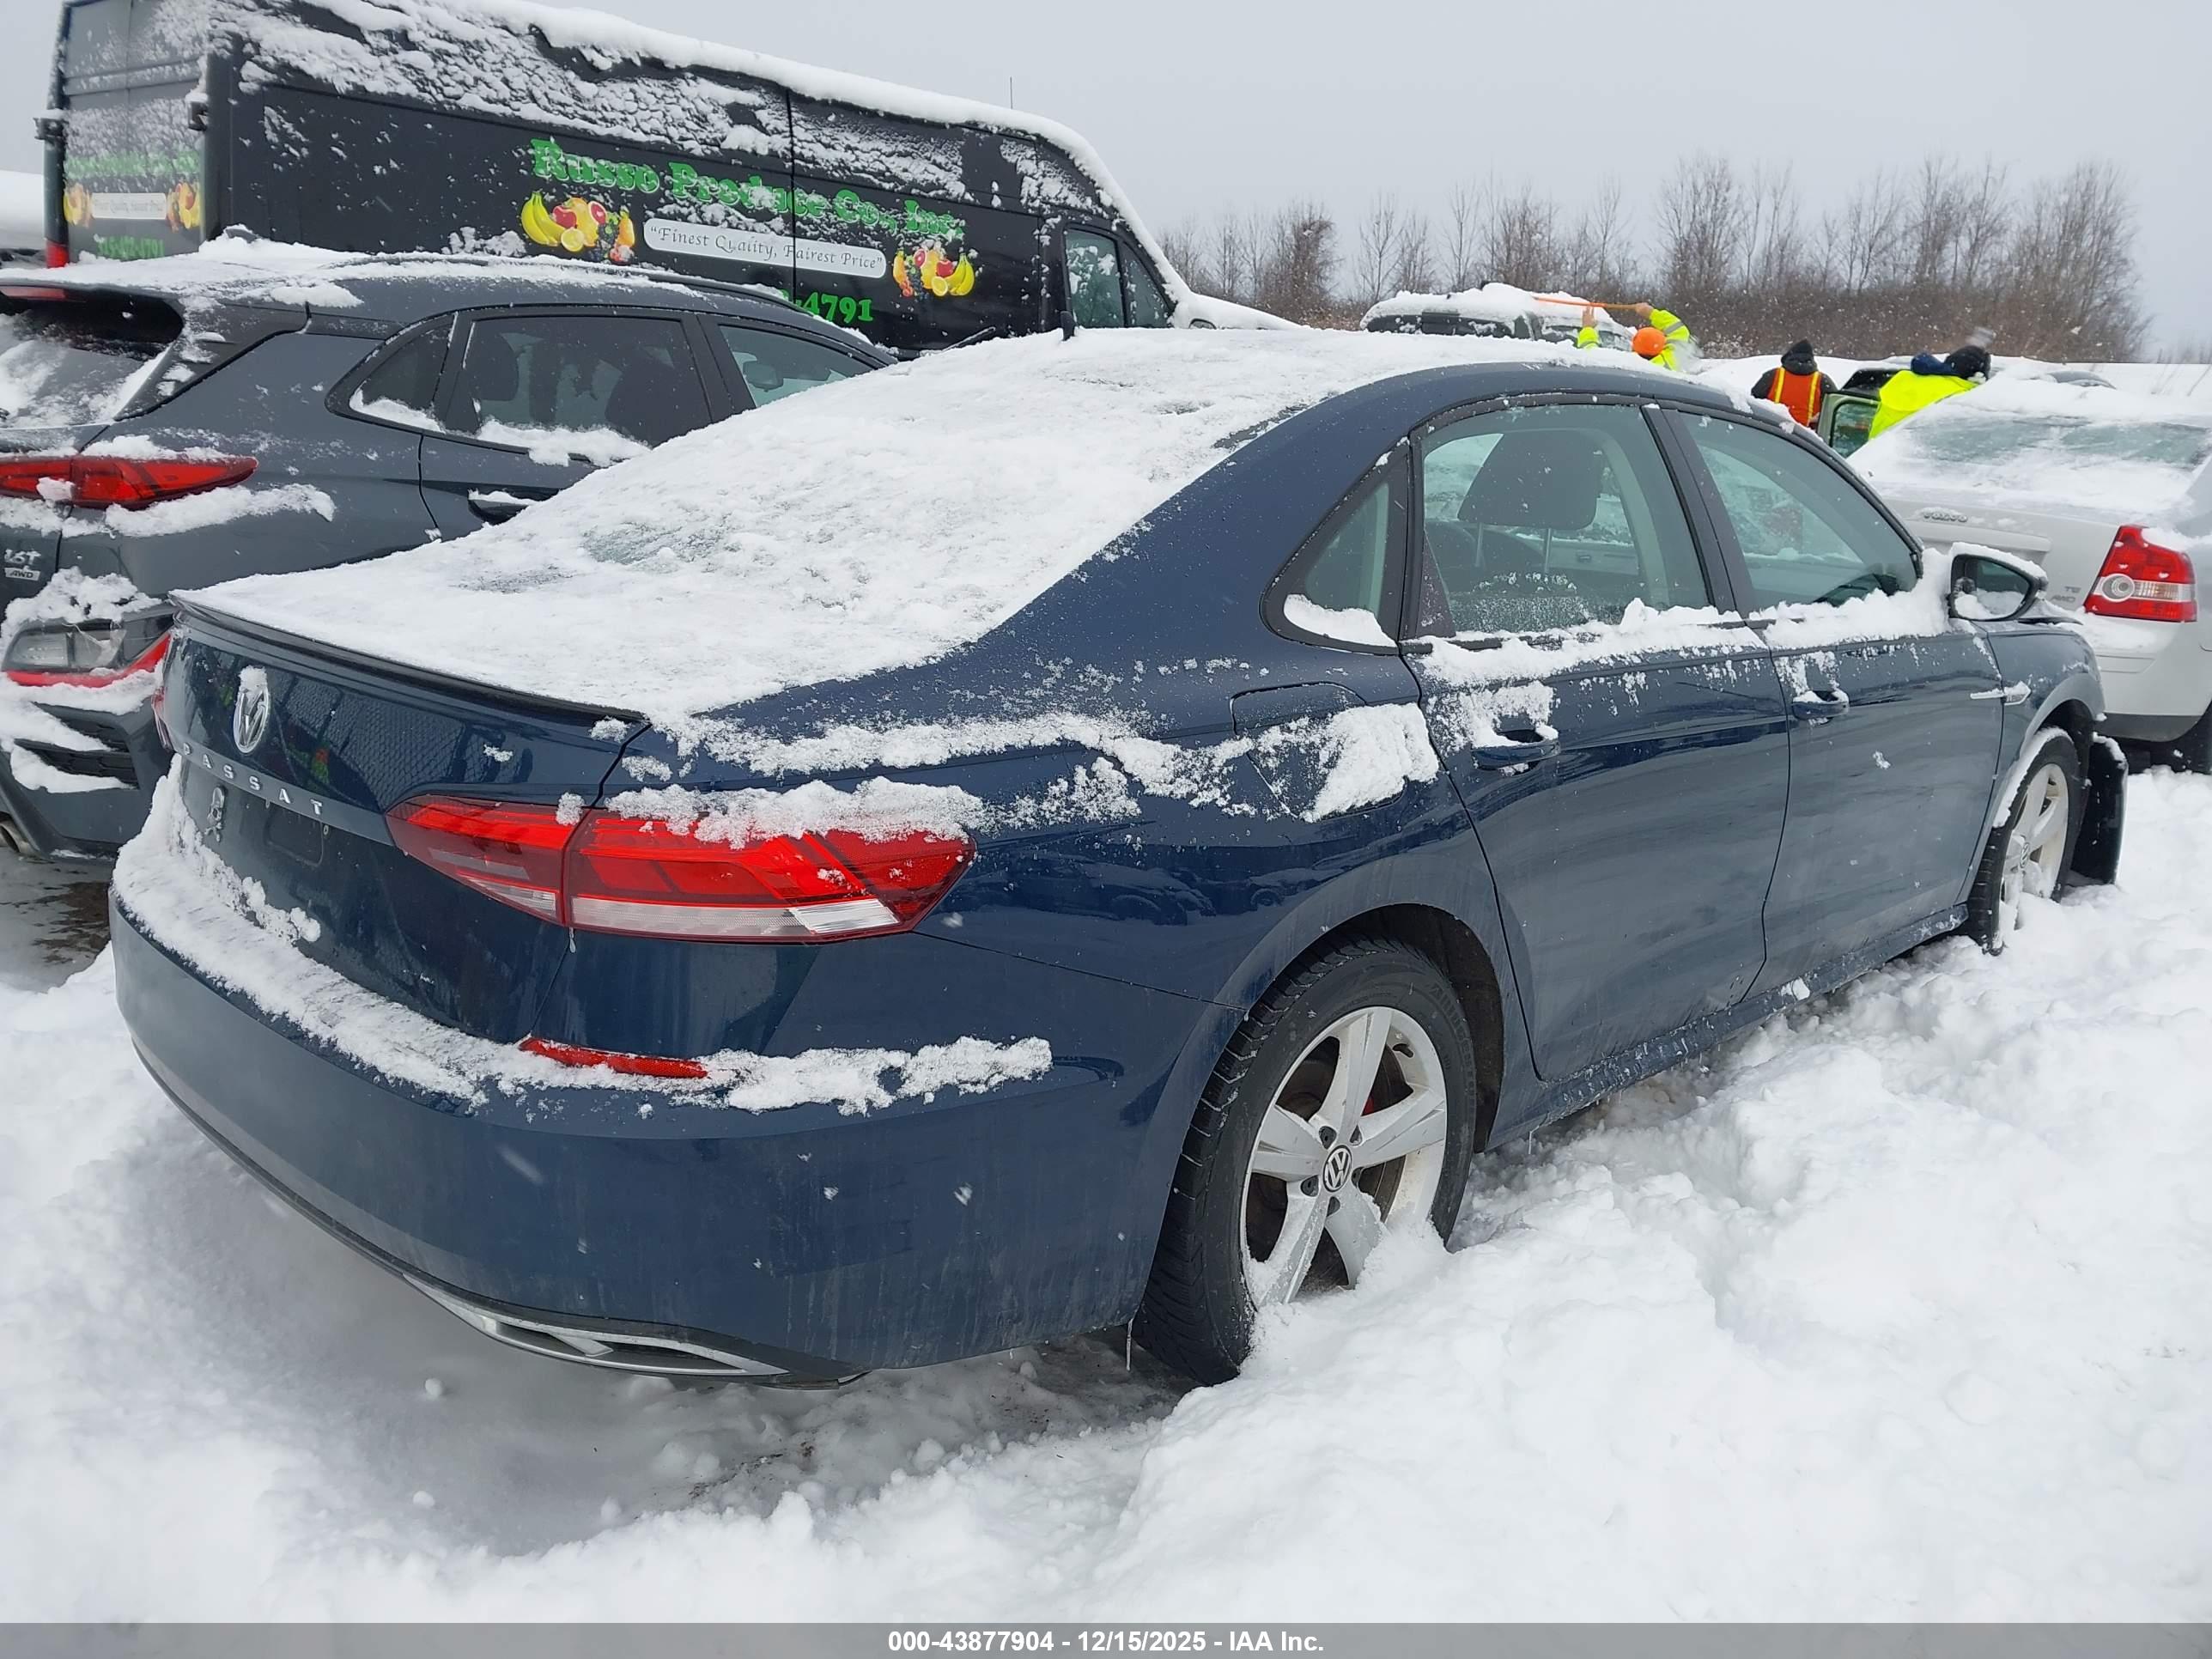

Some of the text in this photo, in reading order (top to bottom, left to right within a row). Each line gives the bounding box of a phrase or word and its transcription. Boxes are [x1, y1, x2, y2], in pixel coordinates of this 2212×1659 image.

[530, 138, 660, 193] Russo
[783, 245, 837, 263] Fairest
[183, 742, 323, 815] PASSAT
